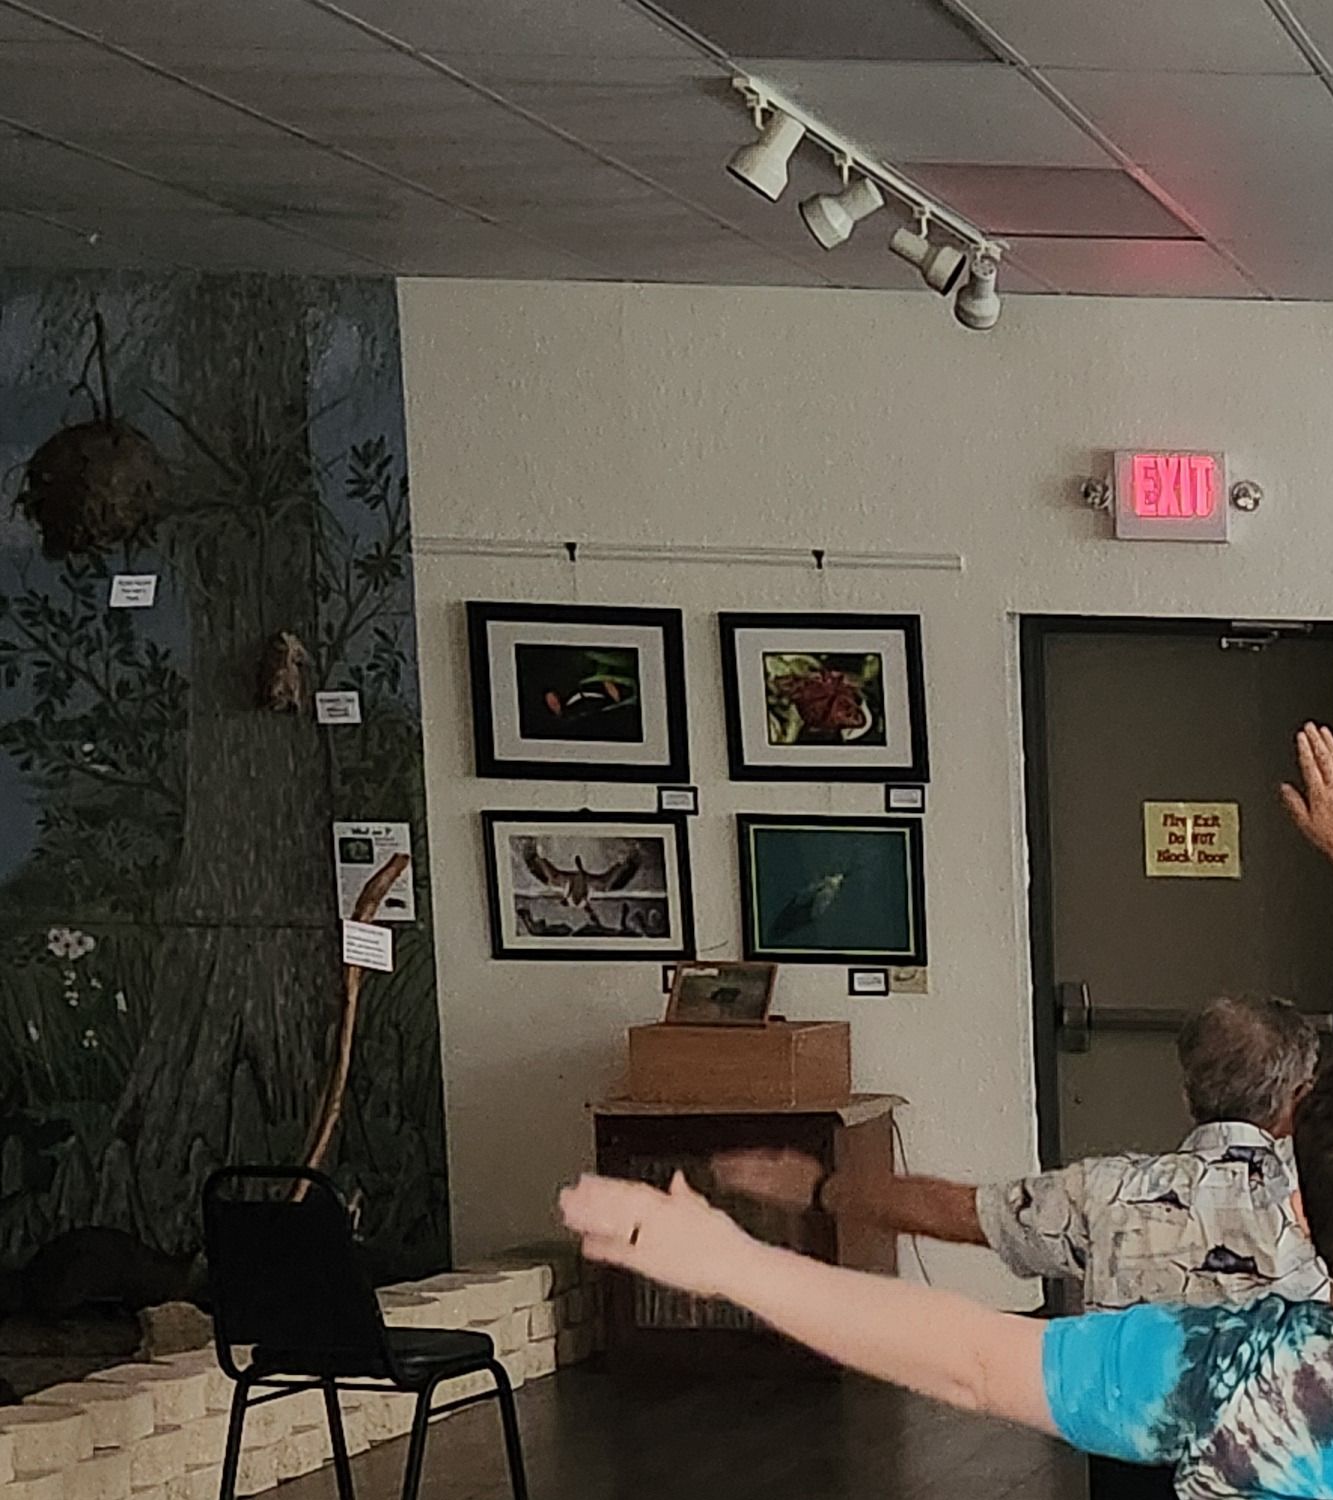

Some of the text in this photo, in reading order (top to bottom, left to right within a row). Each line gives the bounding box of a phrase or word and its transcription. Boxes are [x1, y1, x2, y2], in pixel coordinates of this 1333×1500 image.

[1133, 454, 1215, 517] EXIT
[1193, 814, 1220, 828] Exit
[1168, 832, 1185, 845] Do
[1157, 848, 1229, 864] Block Door
